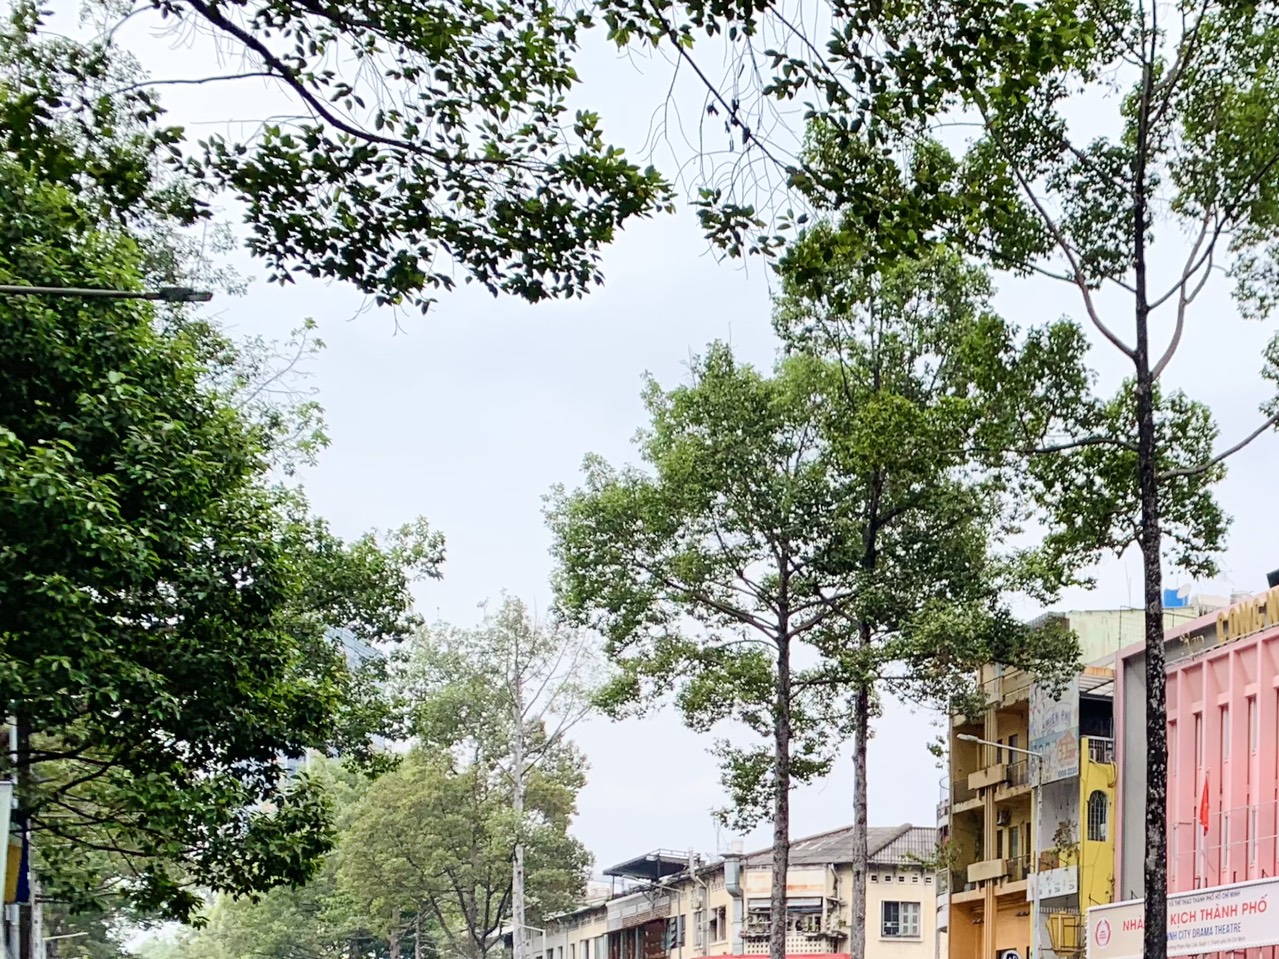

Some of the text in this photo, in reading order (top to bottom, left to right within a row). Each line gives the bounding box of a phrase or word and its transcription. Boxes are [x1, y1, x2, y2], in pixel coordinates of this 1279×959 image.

[1122, 893, 1269, 932] NHÀ KỊCH THÀNH PHỐ
[1178, 928, 1191, 940] CITY
[1192, 926, 1213, 939] DRAMA
[1215, 922, 1242, 935] THEATRE
